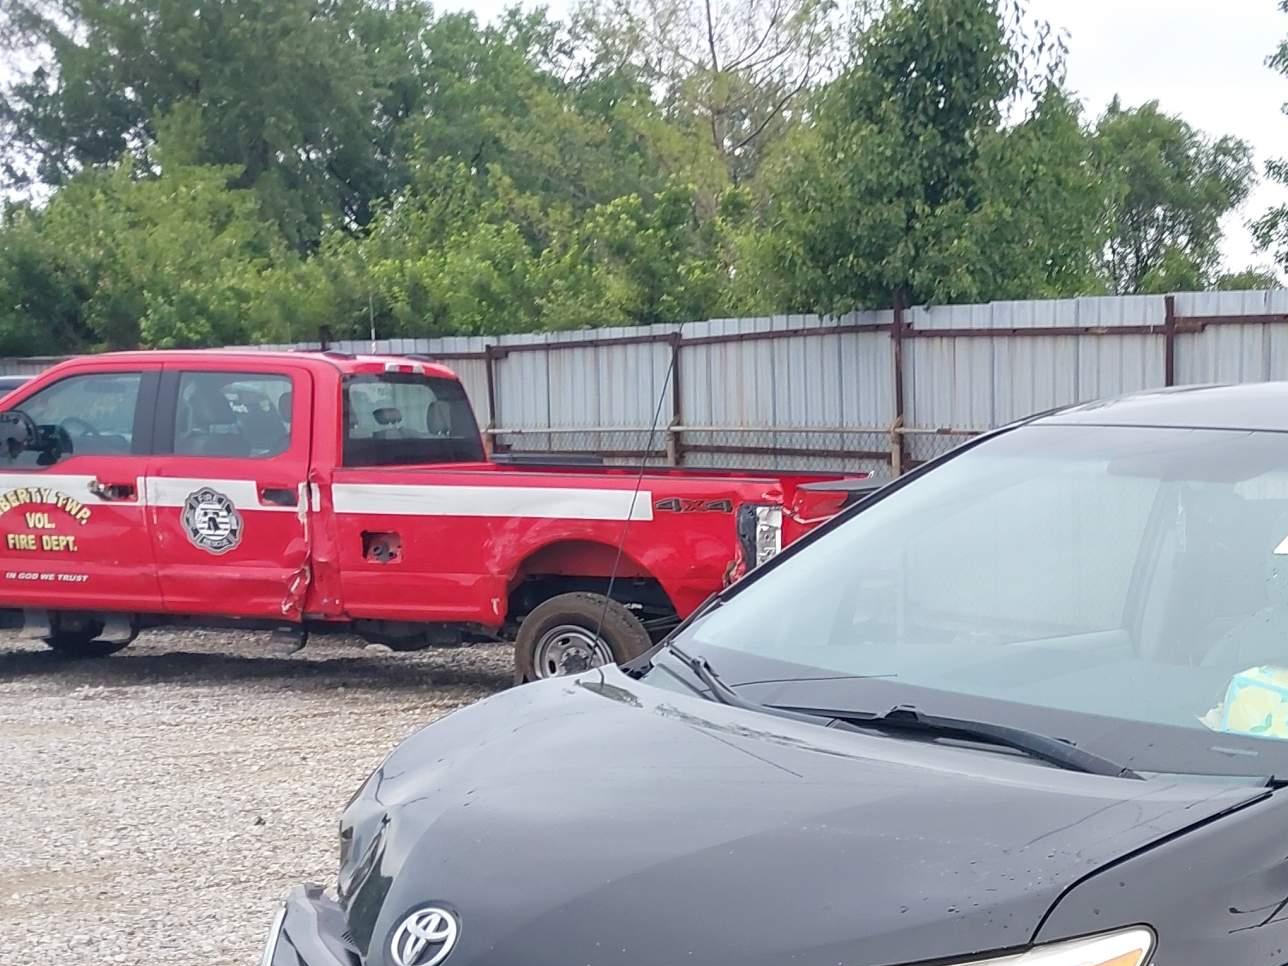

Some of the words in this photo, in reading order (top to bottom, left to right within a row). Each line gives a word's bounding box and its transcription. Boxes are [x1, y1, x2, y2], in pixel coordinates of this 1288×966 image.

[0, 488, 51, 515] BERTY
[56, 491, 92, 525] TWP.
[25, 512, 56, 529] VOL.
[7, 533, 37, 550] FIRE
[41, 535, 78, 551] DEPT.
[18, 572, 39, 580] GOD
[40, 573, 55, 581] WE
[57, 574, 89, 582] TRUST
